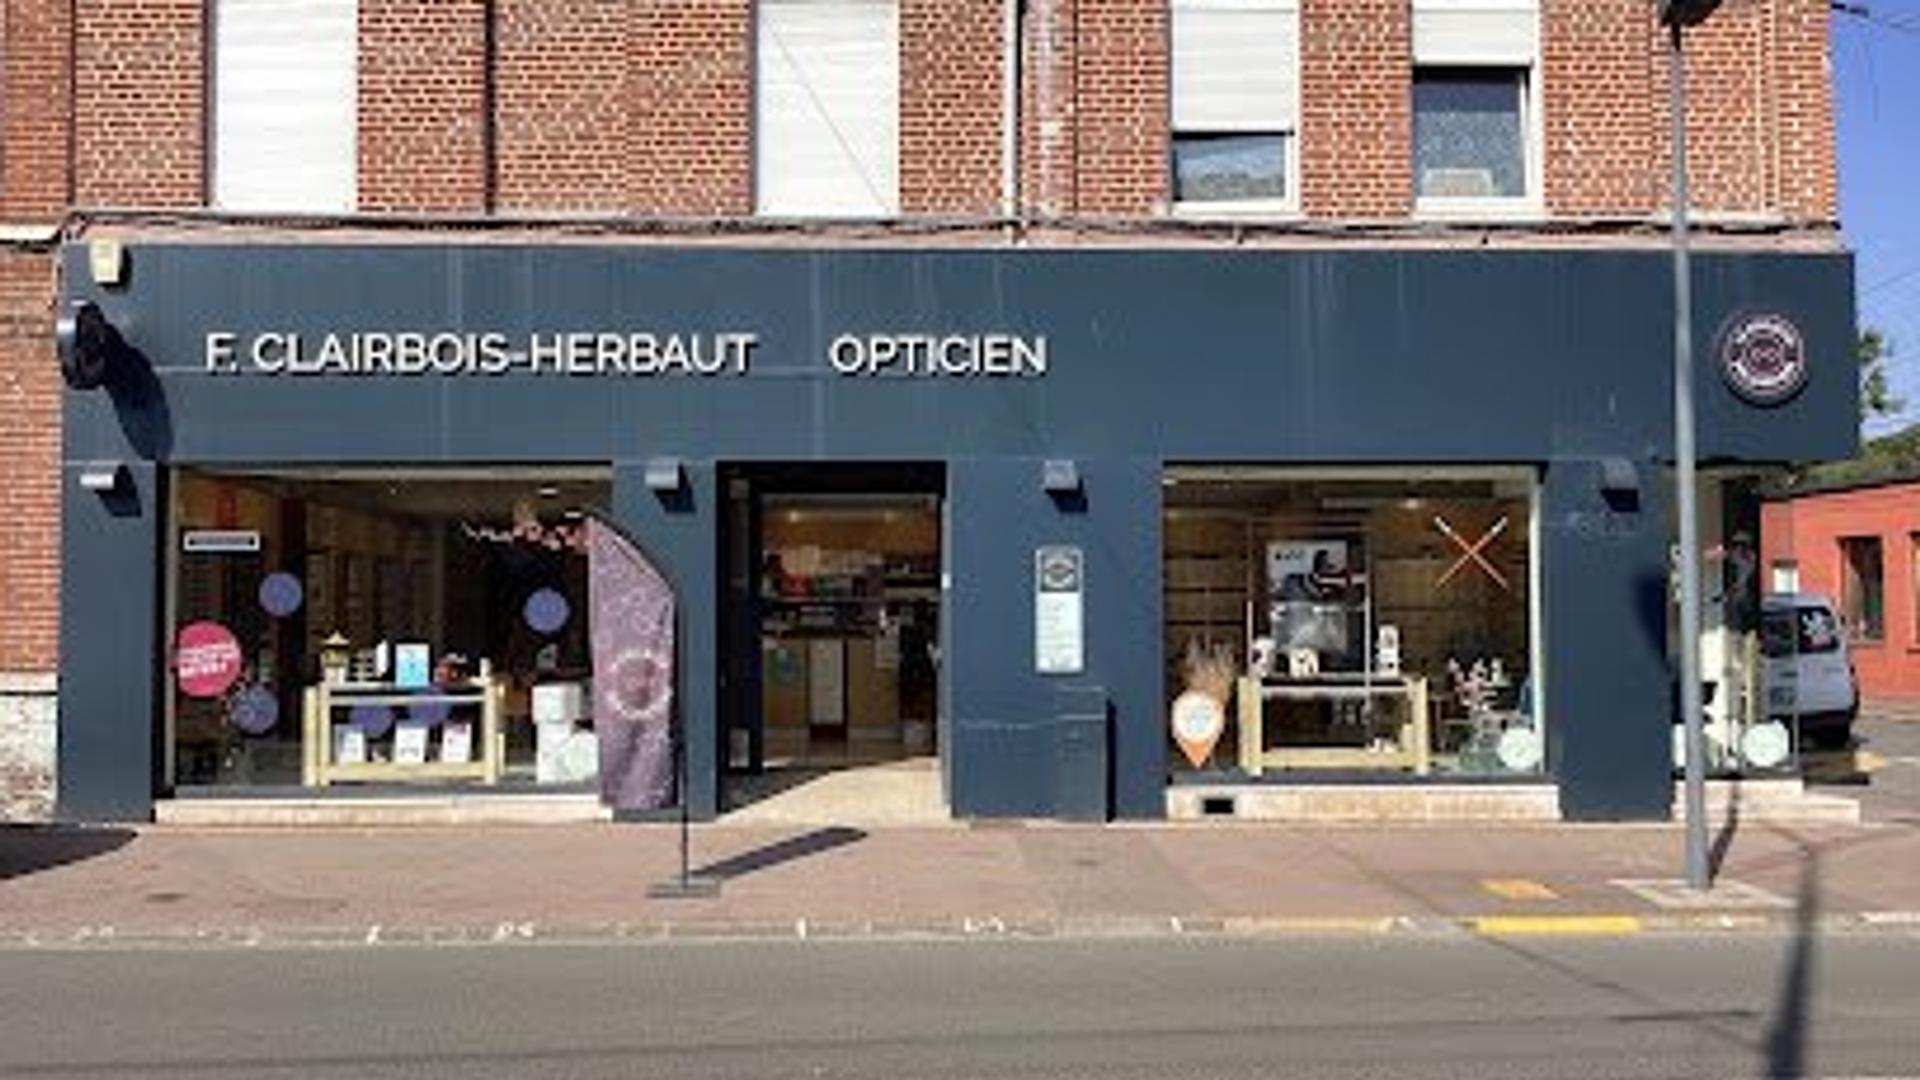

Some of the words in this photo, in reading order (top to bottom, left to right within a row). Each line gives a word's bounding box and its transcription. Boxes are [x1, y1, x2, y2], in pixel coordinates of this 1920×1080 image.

[205, 333, 239, 373] F.
[252, 332, 757, 374] CLAIRBOIS-HERBAUT
[829, 333, 1048, 374] OPTICIEN
